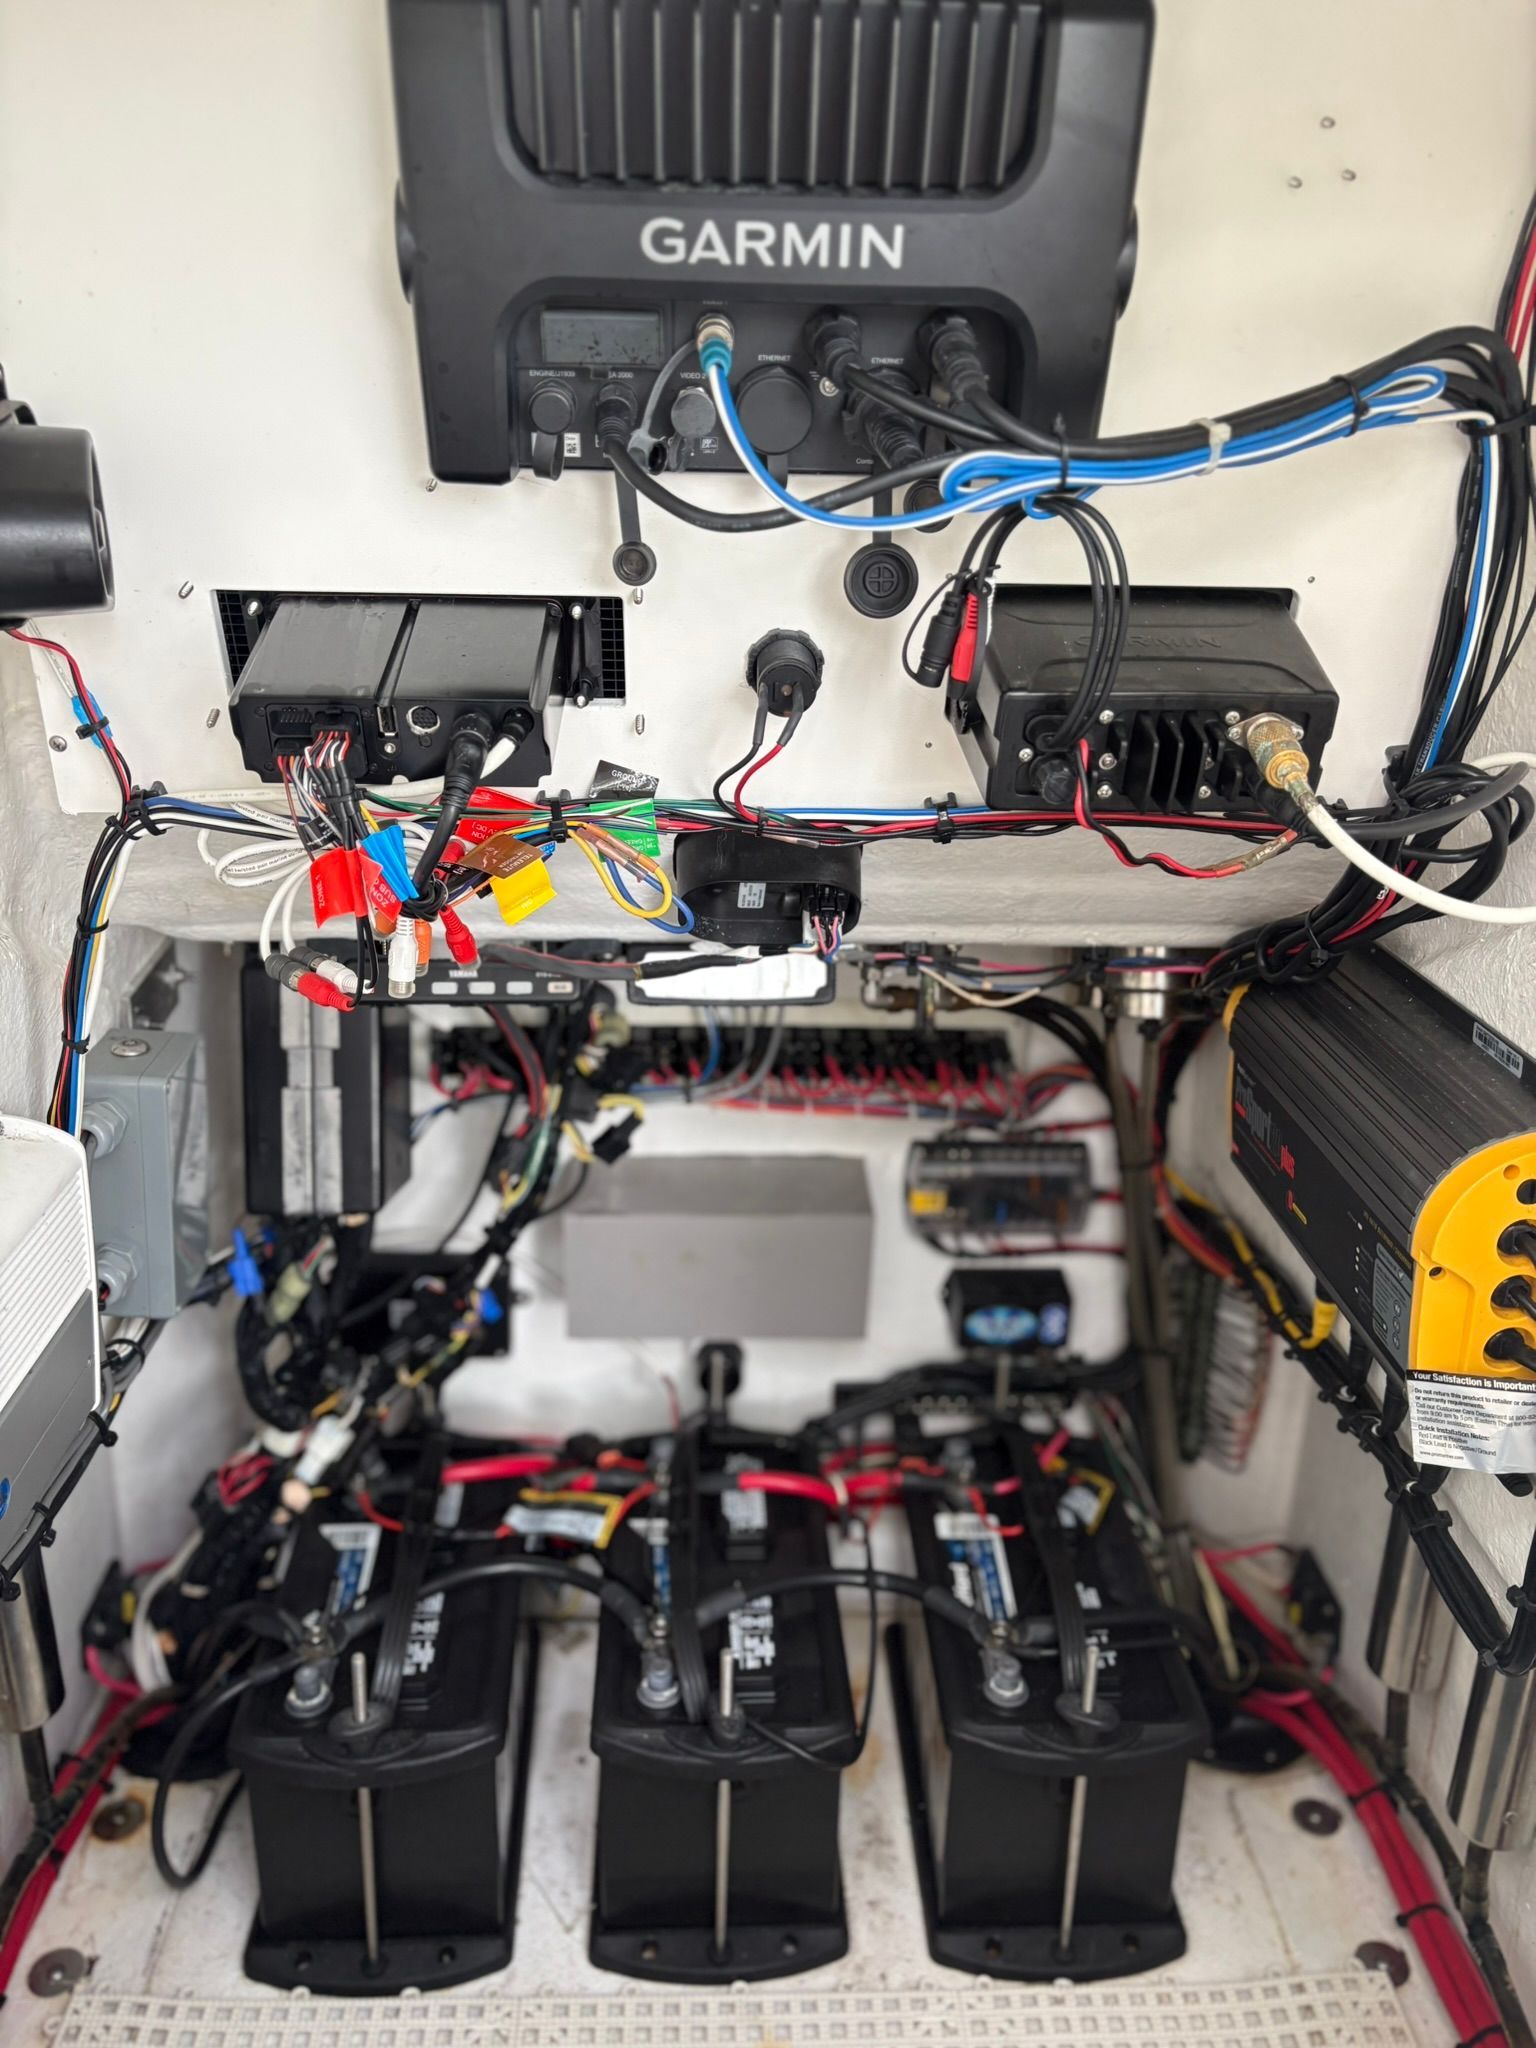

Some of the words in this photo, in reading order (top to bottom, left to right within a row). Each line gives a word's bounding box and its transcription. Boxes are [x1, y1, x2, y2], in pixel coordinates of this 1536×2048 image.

[640, 217, 904, 269] GARMIN
[758, 354, 791, 362] ETHERNET
[871, 357, 904, 365] ETHERNET
[372, 887, 390, 907] ZON
[379, 884, 398, 903] SUB
[1412, 1371, 1431, 1380] Your
[1432, 1373, 1482, 1387] Satisfaction
[1484, 1378, 1492, 1388] is
[1494, 1380, 1536, 1392] Important
[1422, 1396, 1446, 1405] warranty
[1462, 1394, 1485, 1402] product
[1492, 1397, 1512, 1405] retailer
[1436, 1405, 1461, 1413] Customer
[1475, 1409, 1507, 1420] Department
[1417, 1416, 1446, 1425] installation
[1418, 1424, 1435, 1433] Quick
[1436, 1426, 1470, 1437] Installation
[1419, 1431, 1428, 1439] Red
[1448, 1435, 1468, 1444] Positive
[1434, 1440, 1447, 1448] Lead
